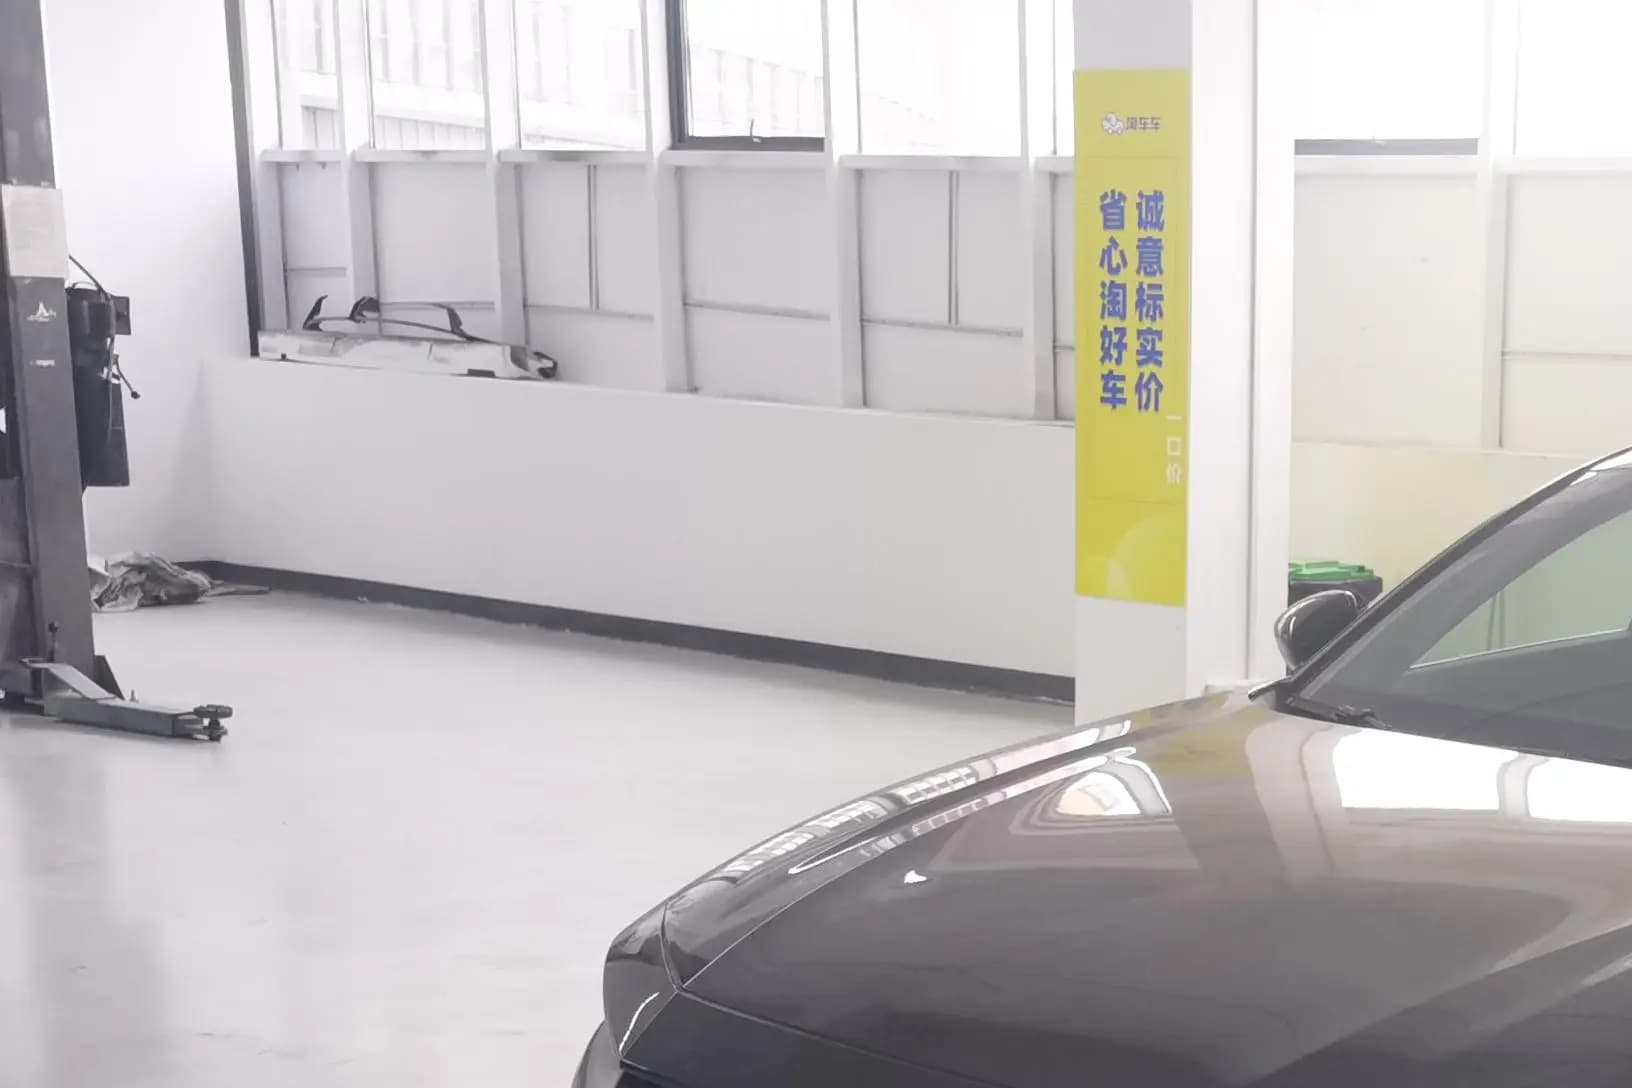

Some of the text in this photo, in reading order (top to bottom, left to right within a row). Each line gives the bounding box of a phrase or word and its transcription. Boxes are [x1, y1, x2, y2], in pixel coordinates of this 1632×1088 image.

[1099, 189, 1128, 411] 省心淘好车
[1135, 190, 1165, 412] 诚意标实价
[1167, 416, 1183, 485] 一口价
